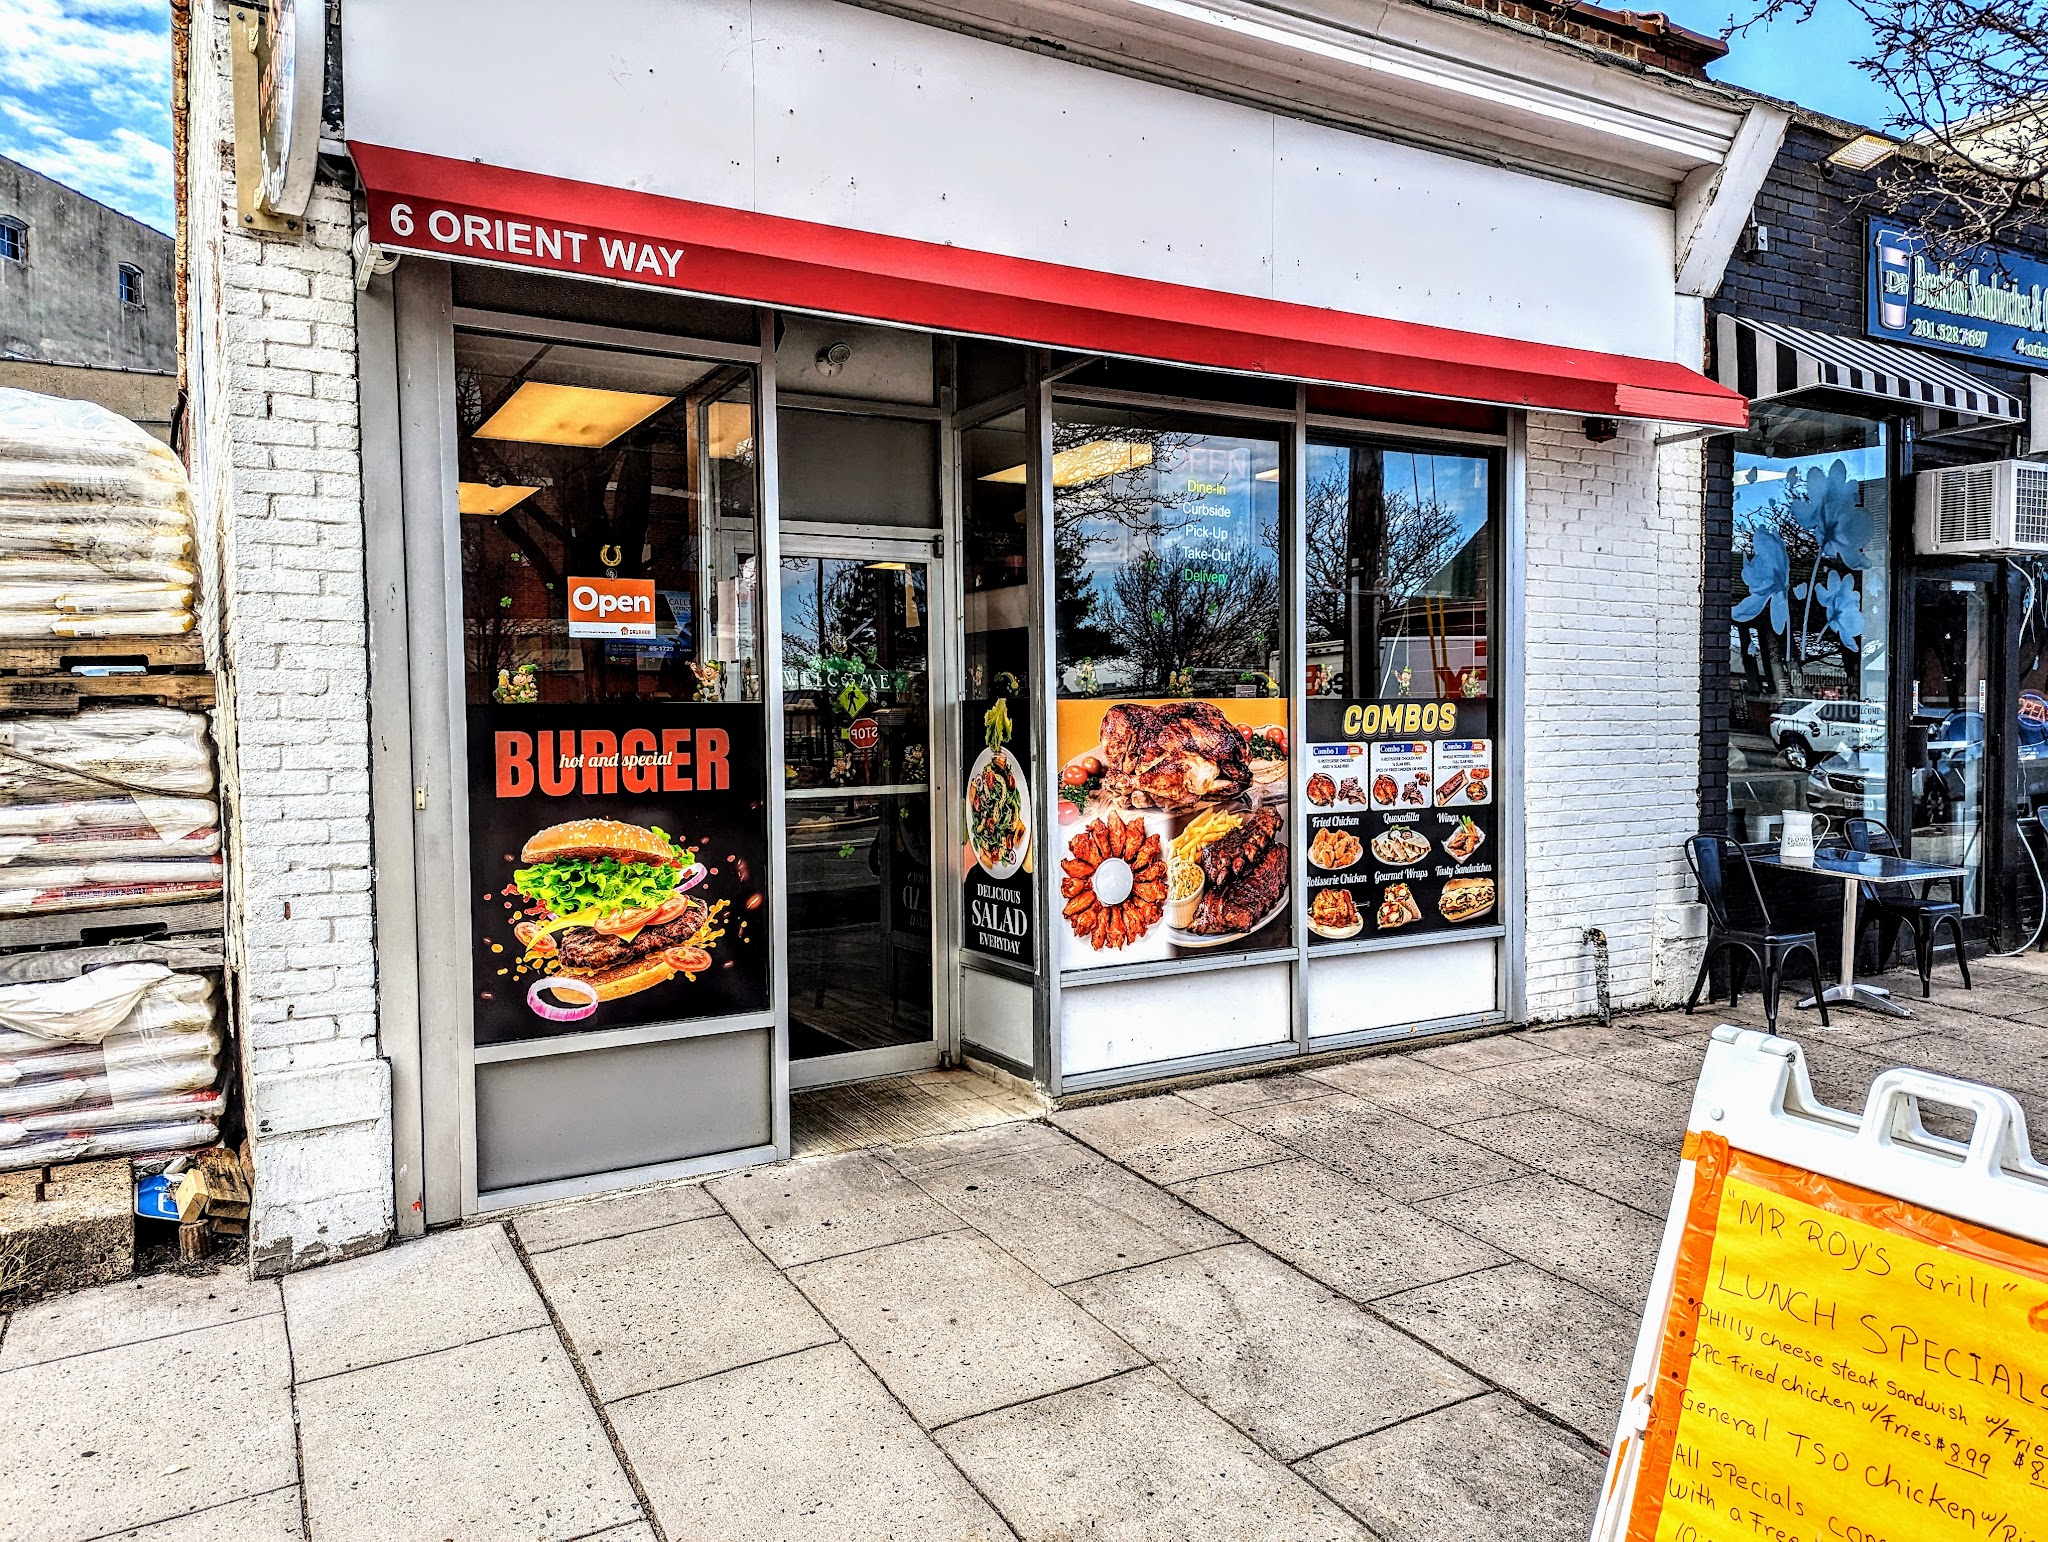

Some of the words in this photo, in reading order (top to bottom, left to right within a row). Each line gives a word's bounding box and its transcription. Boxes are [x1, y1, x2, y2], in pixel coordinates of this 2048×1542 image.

[390, 203, 415, 237] 6
[428, 209, 588, 264] ORIENT
[598, 236, 685, 278] WAY
[1969, 268, 2031, 329] Sandwiches
[2025, 341, 2048, 360] orie
[1187, 479, 1227, 496] Dine-In
[1182, 502, 1231, 519] Curbside
[1185, 524, 1229, 542] Pick-Up
[1182, 546, 1232, 563] Take-Out
[1184, 568, 1229, 587] Delivery
[572, 585, 651, 618] Open
[1343, 702, 1457, 737] COMBOS
[1313, 746, 1335, 755] Combo
[1380, 745, 1400, 753] Combo
[494, 728, 730, 798] BURGER
[559, 753, 585, 769] hot
[588, 753, 619, 767] and
[621, 751, 673, 771] special
[1311, 817, 1331, 828] Fried
[1331, 815, 1359, 826] Chicken
[1383, 812, 1420, 823] Quesadilla
[1436, 813, 1459, 825] Wings
[1340, 873, 1367, 884] Chicken
[1374, 870, 1404, 884] Gourmet
[1405, 868, 1428, 880] Wraps
[1435, 865, 1454, 877] Tasty
[1455, 863, 1492, 875] Sandwiches
[976, 883, 1021, 905] DELICIOUS
[971, 899, 1028, 937] SALAD
[978, 931, 1021, 955] EVERYDAY
[1718, 1255, 1837, 1330] LUNCH
[1727, 1355, 1779, 1383] Fried
[1679, 1389, 1769, 1441] General
[1788, 1431, 1850, 1471] TSO
[1729, 1507, 1743, 1524] a
